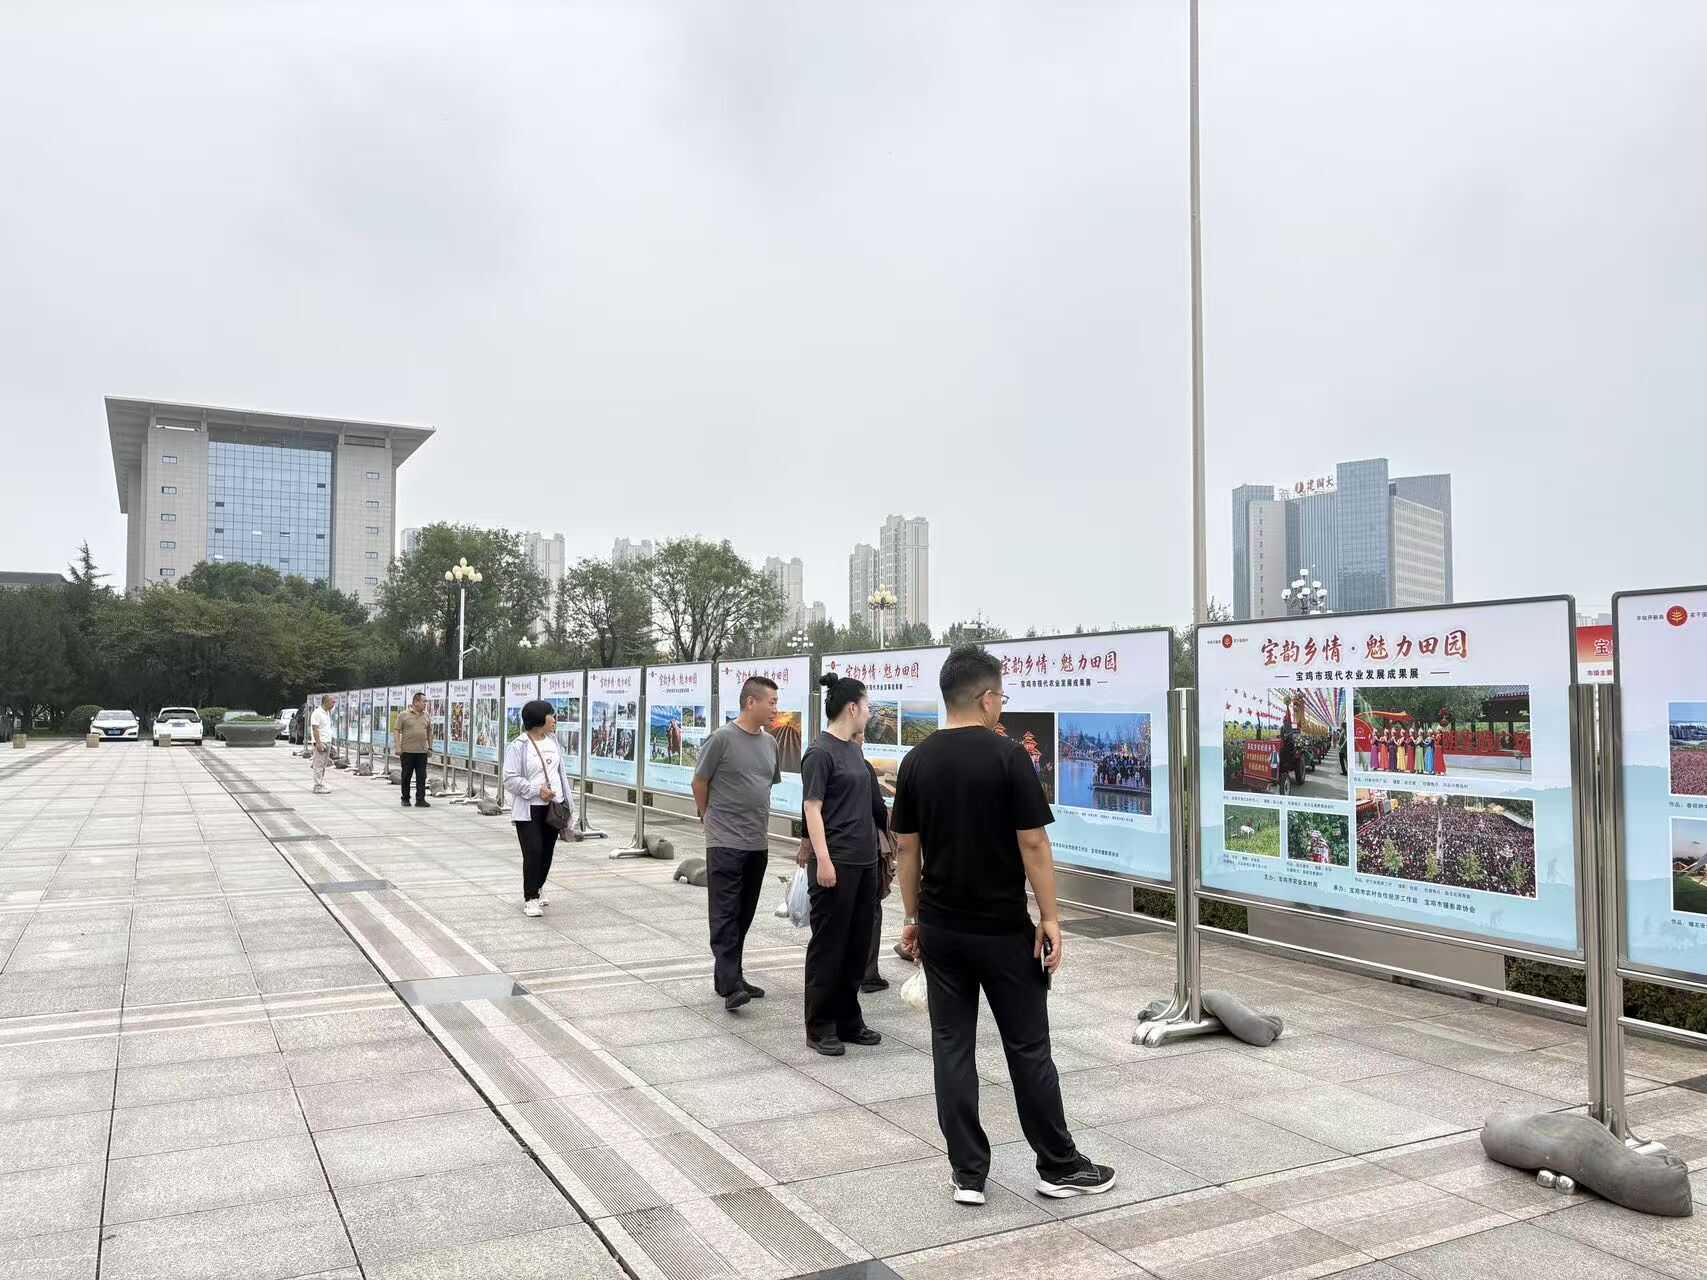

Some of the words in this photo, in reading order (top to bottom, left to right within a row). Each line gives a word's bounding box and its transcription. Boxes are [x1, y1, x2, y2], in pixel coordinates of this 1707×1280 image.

[1261, 629, 1469, 667] 宝韵乡情·魅力田园
[1000, 650, 1118, 676] 宝韵乡情·魅力田园
[1295, 667, 1419, 682] 宝鸡市现代农业发展成果展
